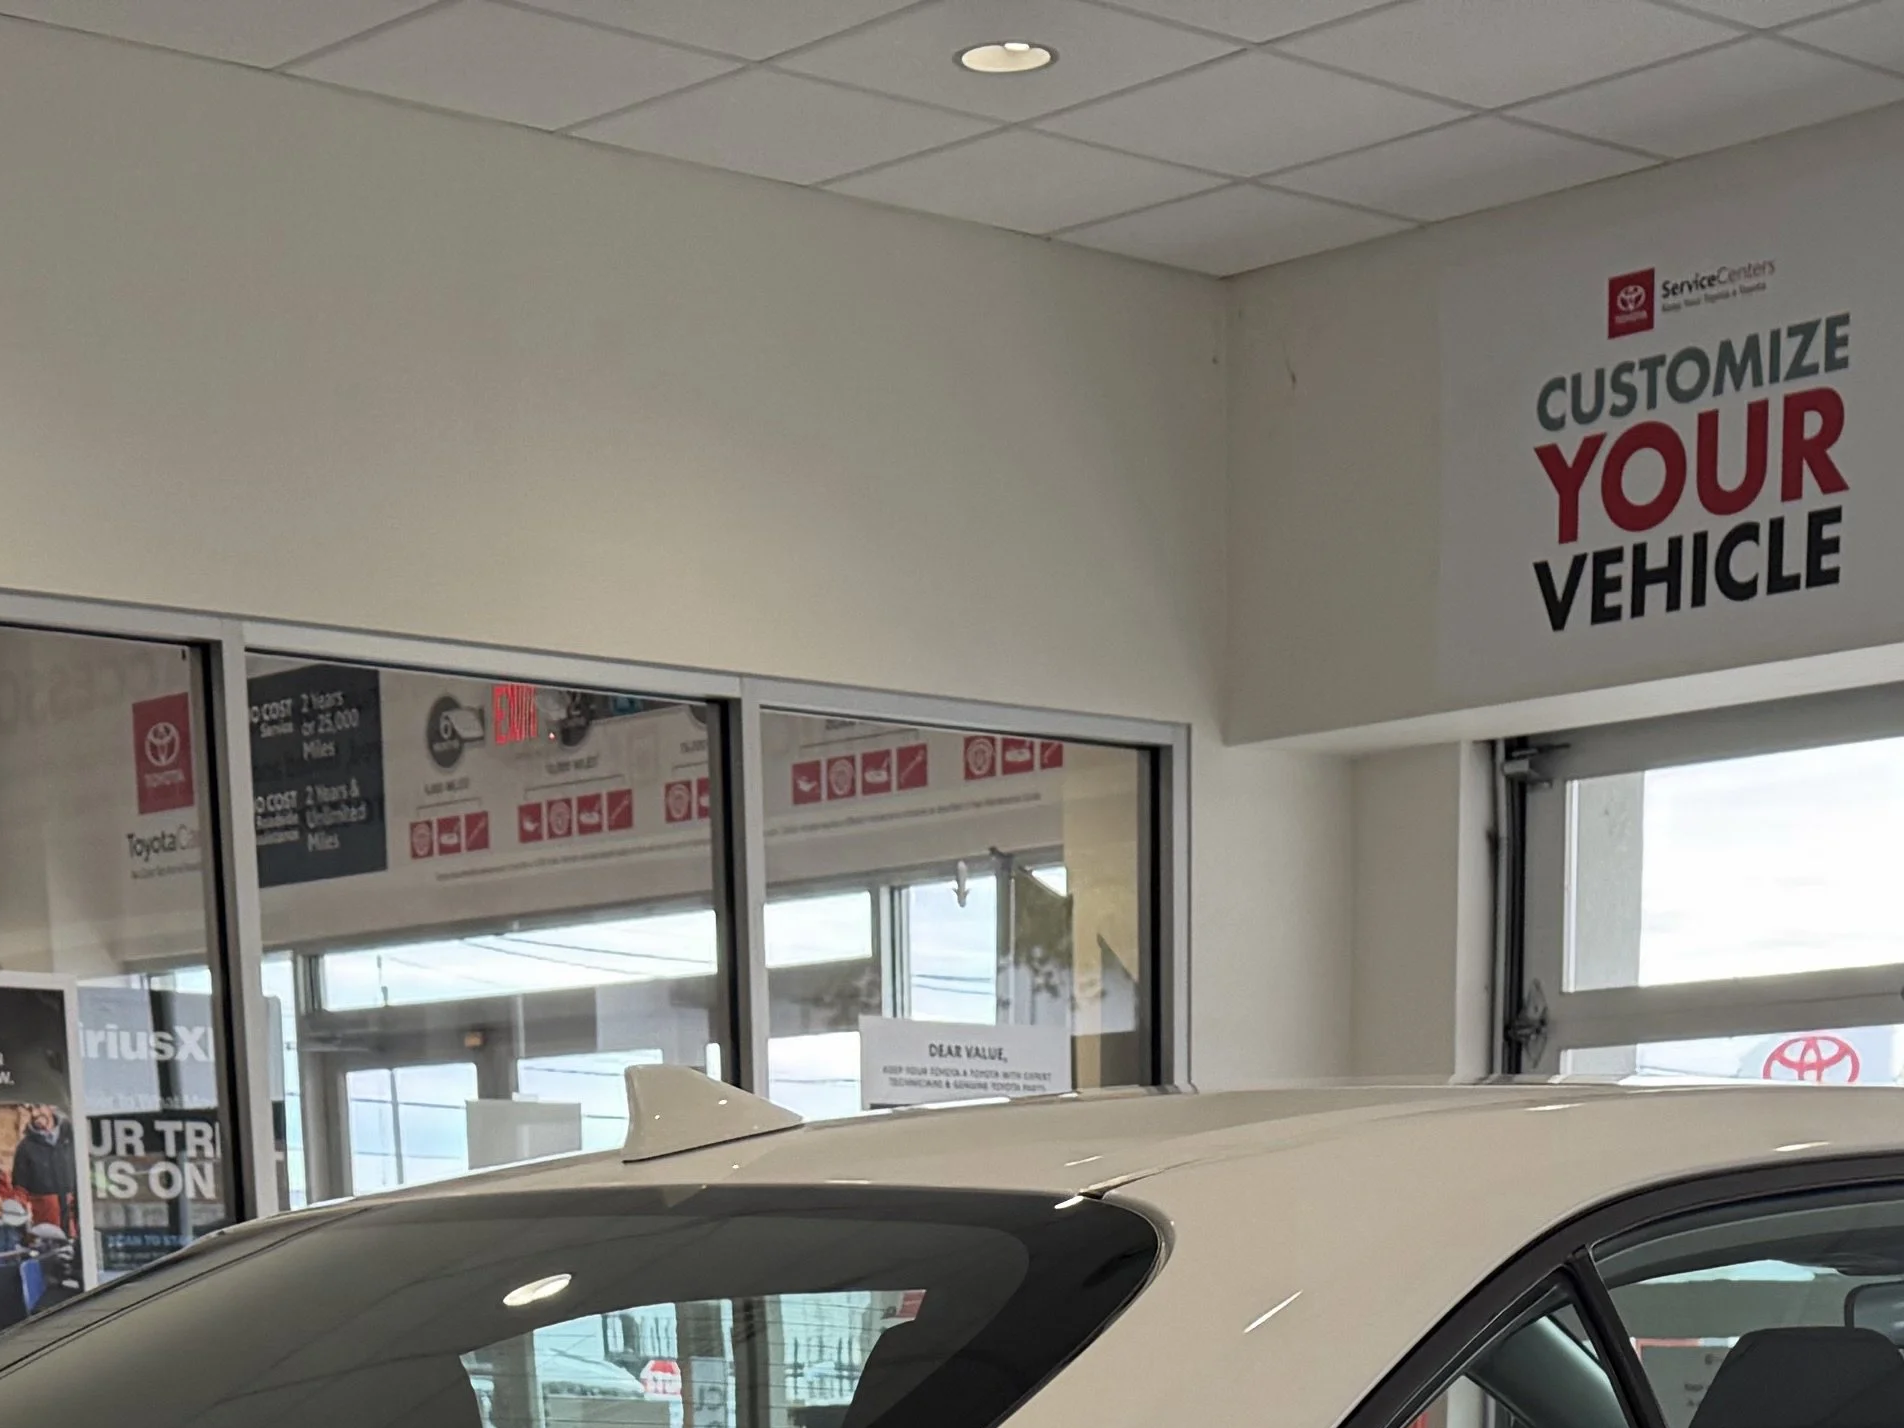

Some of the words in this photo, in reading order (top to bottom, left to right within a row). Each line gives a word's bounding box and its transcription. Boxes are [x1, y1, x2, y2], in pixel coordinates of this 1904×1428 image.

[1537, 312, 1851, 432] CUSTOMIZE
[1533, 387, 1851, 545] YOUR
[1532, 505, 1844, 632] VEHICLE
[262, 698, 293, 721] COST
[310, 691, 344, 710] Years
[302, 740, 336, 761] Miles
[267, 789, 298, 811] COST
[315, 783, 349, 804] Years
[307, 831, 340, 853] Miles
[928, 1043, 962, 1059] DEAR
[965, 1045, 1009, 1064] VALUE,
[929, 1066, 961, 1078] TOYOTA
[970, 1068, 999, 1079] TOYOTA
[96, 1160, 138, 1199] IS
[149, 1160, 216, 1200] ON
